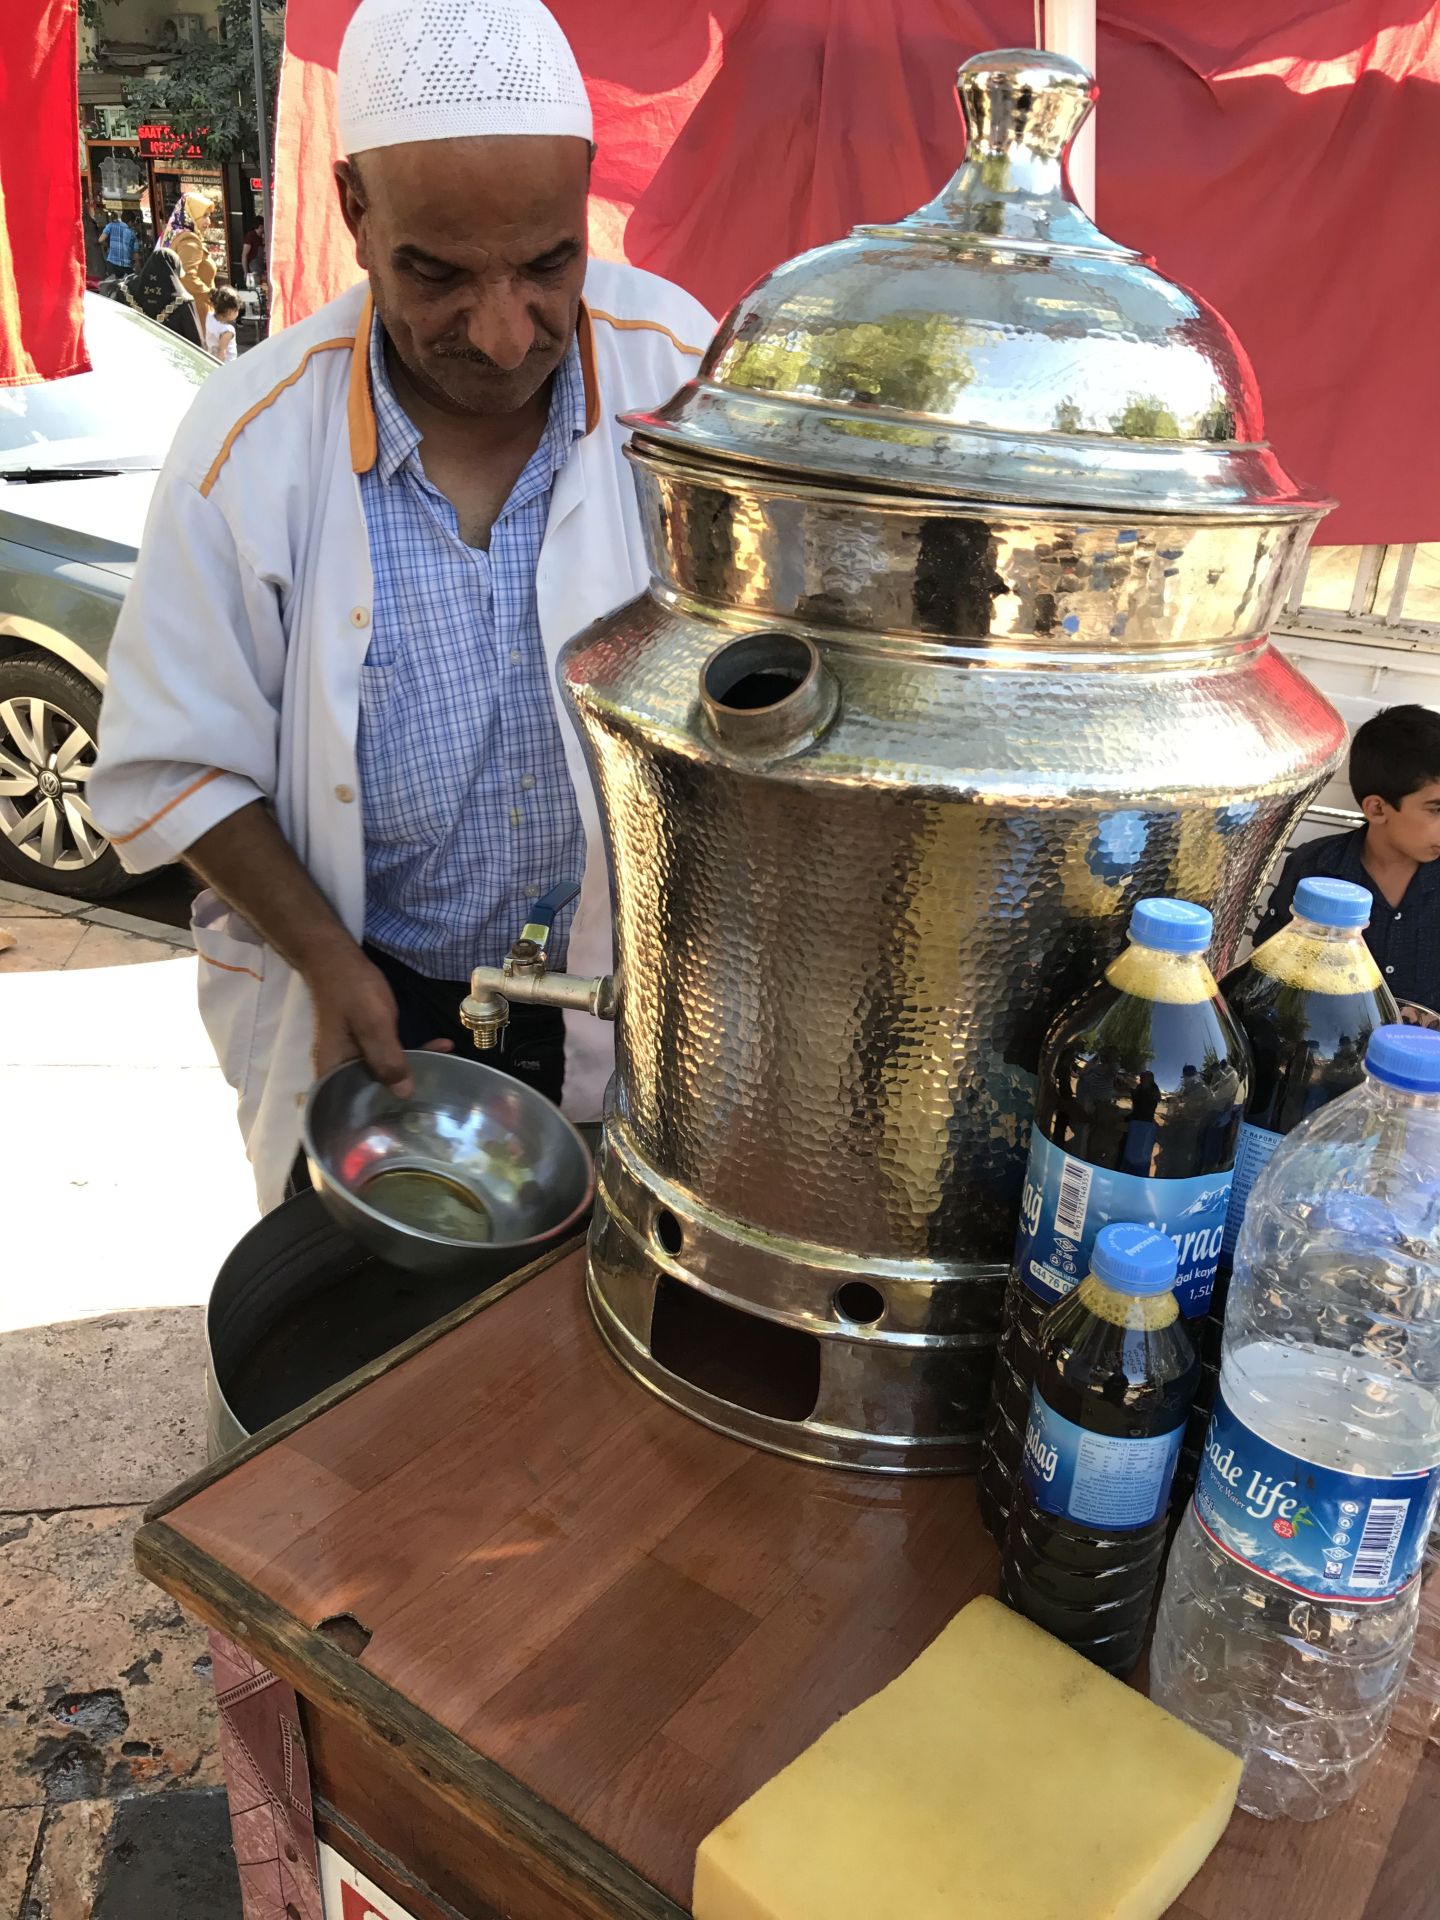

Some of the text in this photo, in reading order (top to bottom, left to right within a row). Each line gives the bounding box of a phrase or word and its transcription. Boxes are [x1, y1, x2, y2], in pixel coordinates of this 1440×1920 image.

[138, 127, 162, 139] SAAT
[1031, 1263, 1047, 1281] 444
[1049, 1277, 1060, 1289] 76
[1204, 1413, 1243, 1487] Sade
[1246, 1470, 1298, 1519] life
[1225, 1486, 1246, 1509] Water
